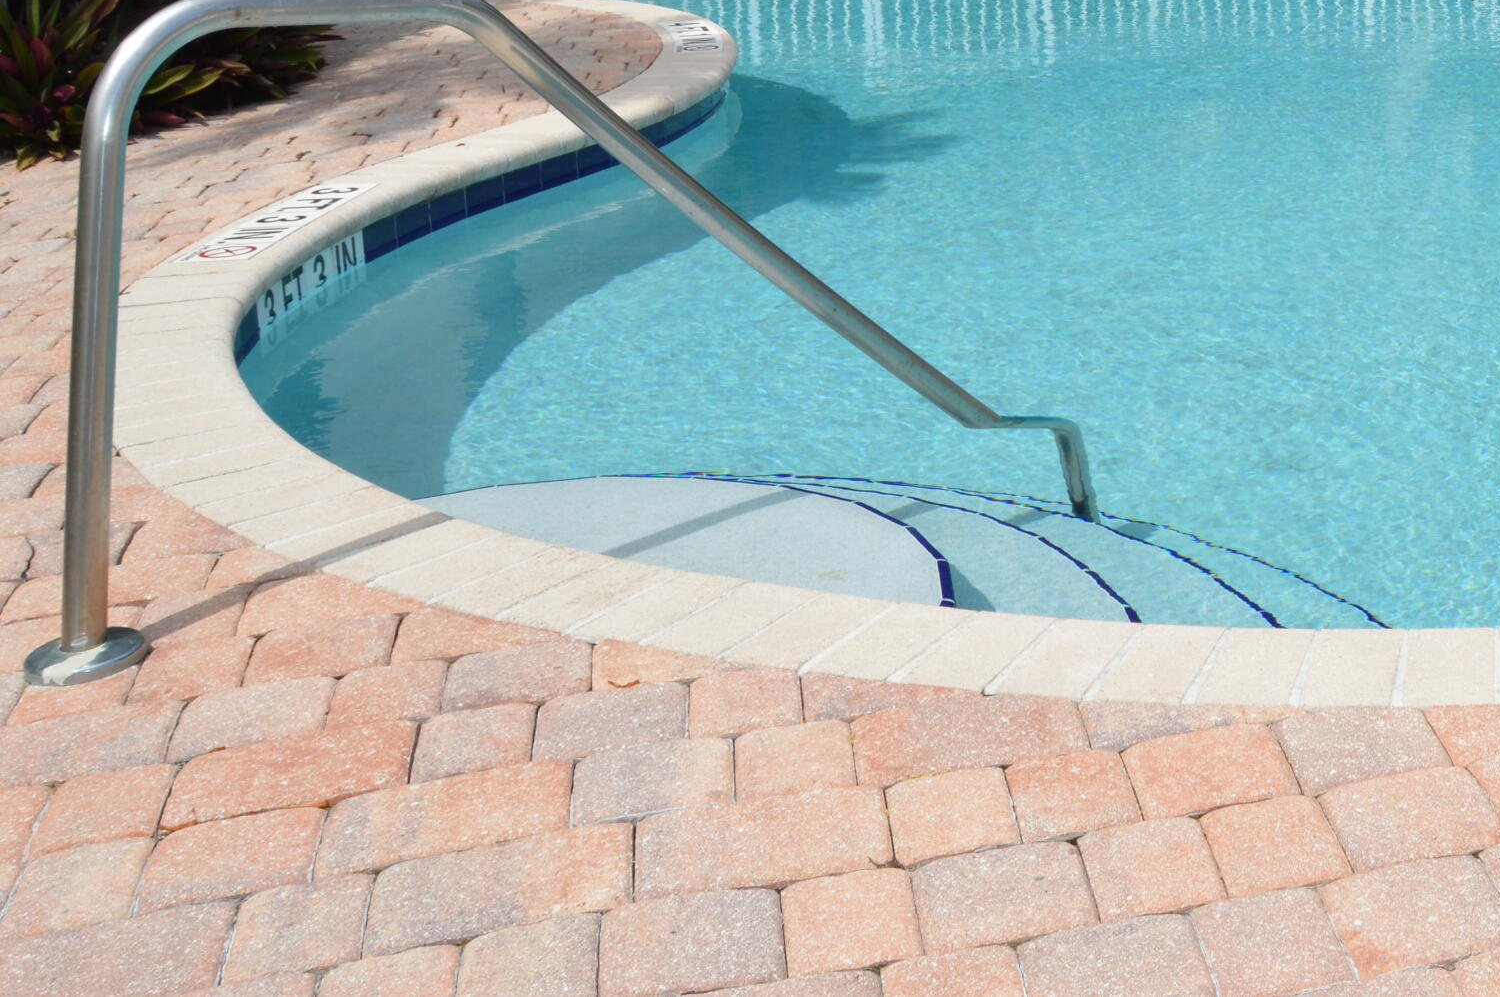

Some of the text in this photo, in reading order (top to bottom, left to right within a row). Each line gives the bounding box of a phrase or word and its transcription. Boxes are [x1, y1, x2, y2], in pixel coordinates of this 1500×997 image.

[311, 186, 360, 195] 3
[256, 215, 308, 223] 3
[264, 288, 276, 326] 3
[313, 254, 328, 288] 3
